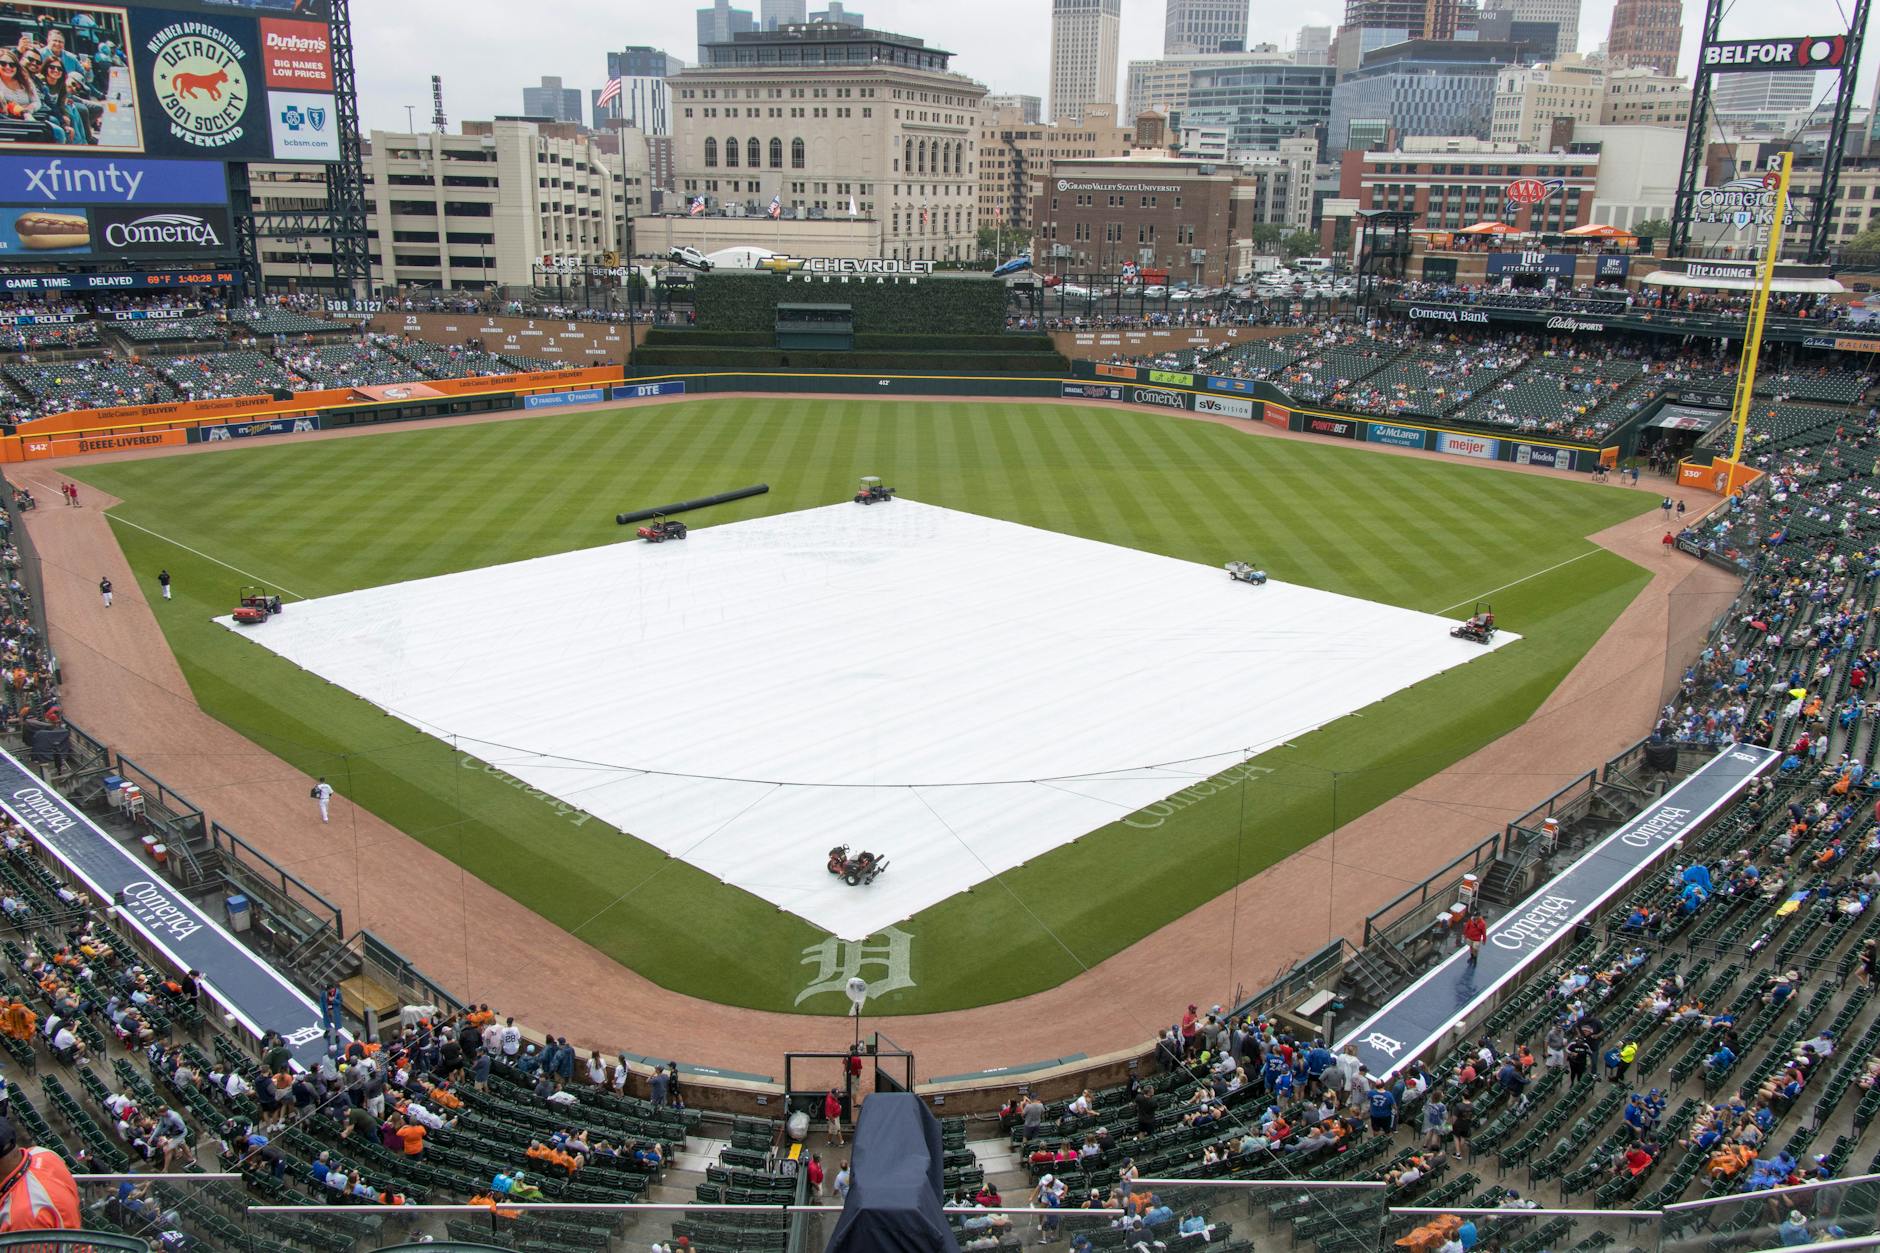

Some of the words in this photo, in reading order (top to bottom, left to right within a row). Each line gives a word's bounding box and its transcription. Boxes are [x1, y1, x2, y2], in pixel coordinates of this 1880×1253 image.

[1479, 12, 1496, 20] 1001
[147, 23, 183, 54] MEMBER
[183, 22, 247, 60] APPRECIATION
[267, 33, 326, 50] Dunham's
[162, 41, 234, 68] DETROIT
[1705, 44, 1793, 65] BELFOR
[274, 60, 290, 68] BIG
[292, 61, 323, 70] NAMES
[273, 69, 292, 77] LOW
[295, 69, 327, 79] PRICES
[162, 92, 191, 125] 1901
[195, 92, 244, 131] SOCIETY
[170, 122, 244, 148] WEEKEND
[284, 139, 328, 148] bcbsm.com
[24, 159, 144, 200] xfinity
[1068, 182, 1093, 190] GRAND
[1092, 182, 1117, 191] VALLEY
[1117, 183, 1138, 191] STATE
[1138, 184, 1181, 192] UNIVERSITY
[1510, 180, 1545, 203] AAA
[1521, 251, 1545, 266] Lite
[810, 258, 938, 274] CHEVROLET
[1502, 265, 1543, 273] PITCHER'S
[1687, 264, 1709, 278] Lite
[1709, 265, 1752, 278] LOUNGE
[6, 279, 38, 288] GAME
[41, 278, 71, 287] TIME:
[89, 276, 133, 287] DELAYED
[178, 274, 212, 283] 1:40:28
[218, 273, 233, 282] PM
[786, 275, 918, 284] FOUNTAIN
[327, 301, 349, 311] 508
[355, 301, 381, 312] 3127
[0, 314, 77, 324] CHEVROLET
[115, 310, 185, 321] CHEVROLET
[406, 316, 417, 324] 23
[1460, 310, 1489, 323] Bank
[488, 318, 494, 326] 5
[529, 320, 535, 329] 2
[568, 323, 576, 331] 16
[1547, 316, 1577, 333] Bally
[1578, 322, 1603, 332] SPORTS
[507, 335, 517, 343] 47
[1227, 329, 1238, 337] 42
[549, 338, 554, 346] 3
[637, 385, 660, 396] DTE
[1222, 406, 1248, 414] VISION
[1311, 420, 1348, 434] POINTSBET
[1386, 425, 1419, 439] McLaren
[1449, 438, 1486, 454] meijer
[1532, 451, 1555, 463] Modelo
[1684, 470, 1701, 478] 330'
[16, 804, 45, 825] PARK
[1655, 820, 1686, 840] PARK
[128, 901, 164, 929] PARK
[1533, 909, 1569, 941] PARK
[505, 1034, 516, 1043] 28
